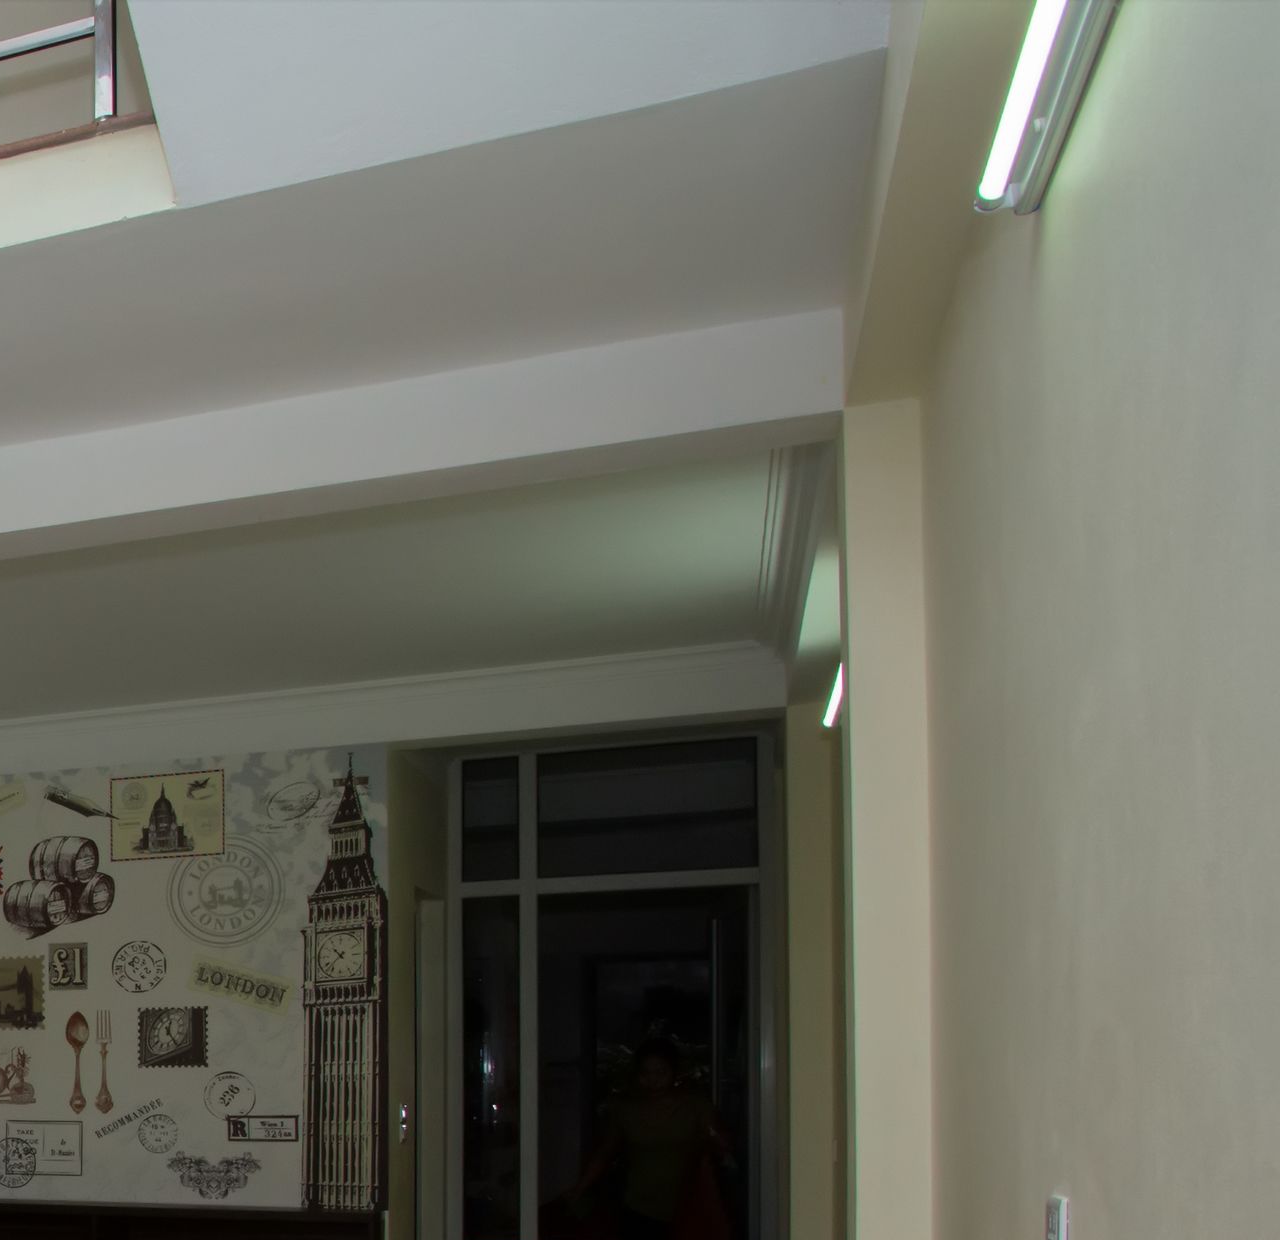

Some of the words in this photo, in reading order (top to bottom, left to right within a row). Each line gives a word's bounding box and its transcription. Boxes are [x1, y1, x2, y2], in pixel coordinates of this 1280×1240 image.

[189, 850, 265, 882] LONDON
[50, 948, 85, 985] £1
[196, 966, 290, 1005] LONDON
[217, 1083, 241, 1108] 236
[231, 1120, 247, 1138] R
